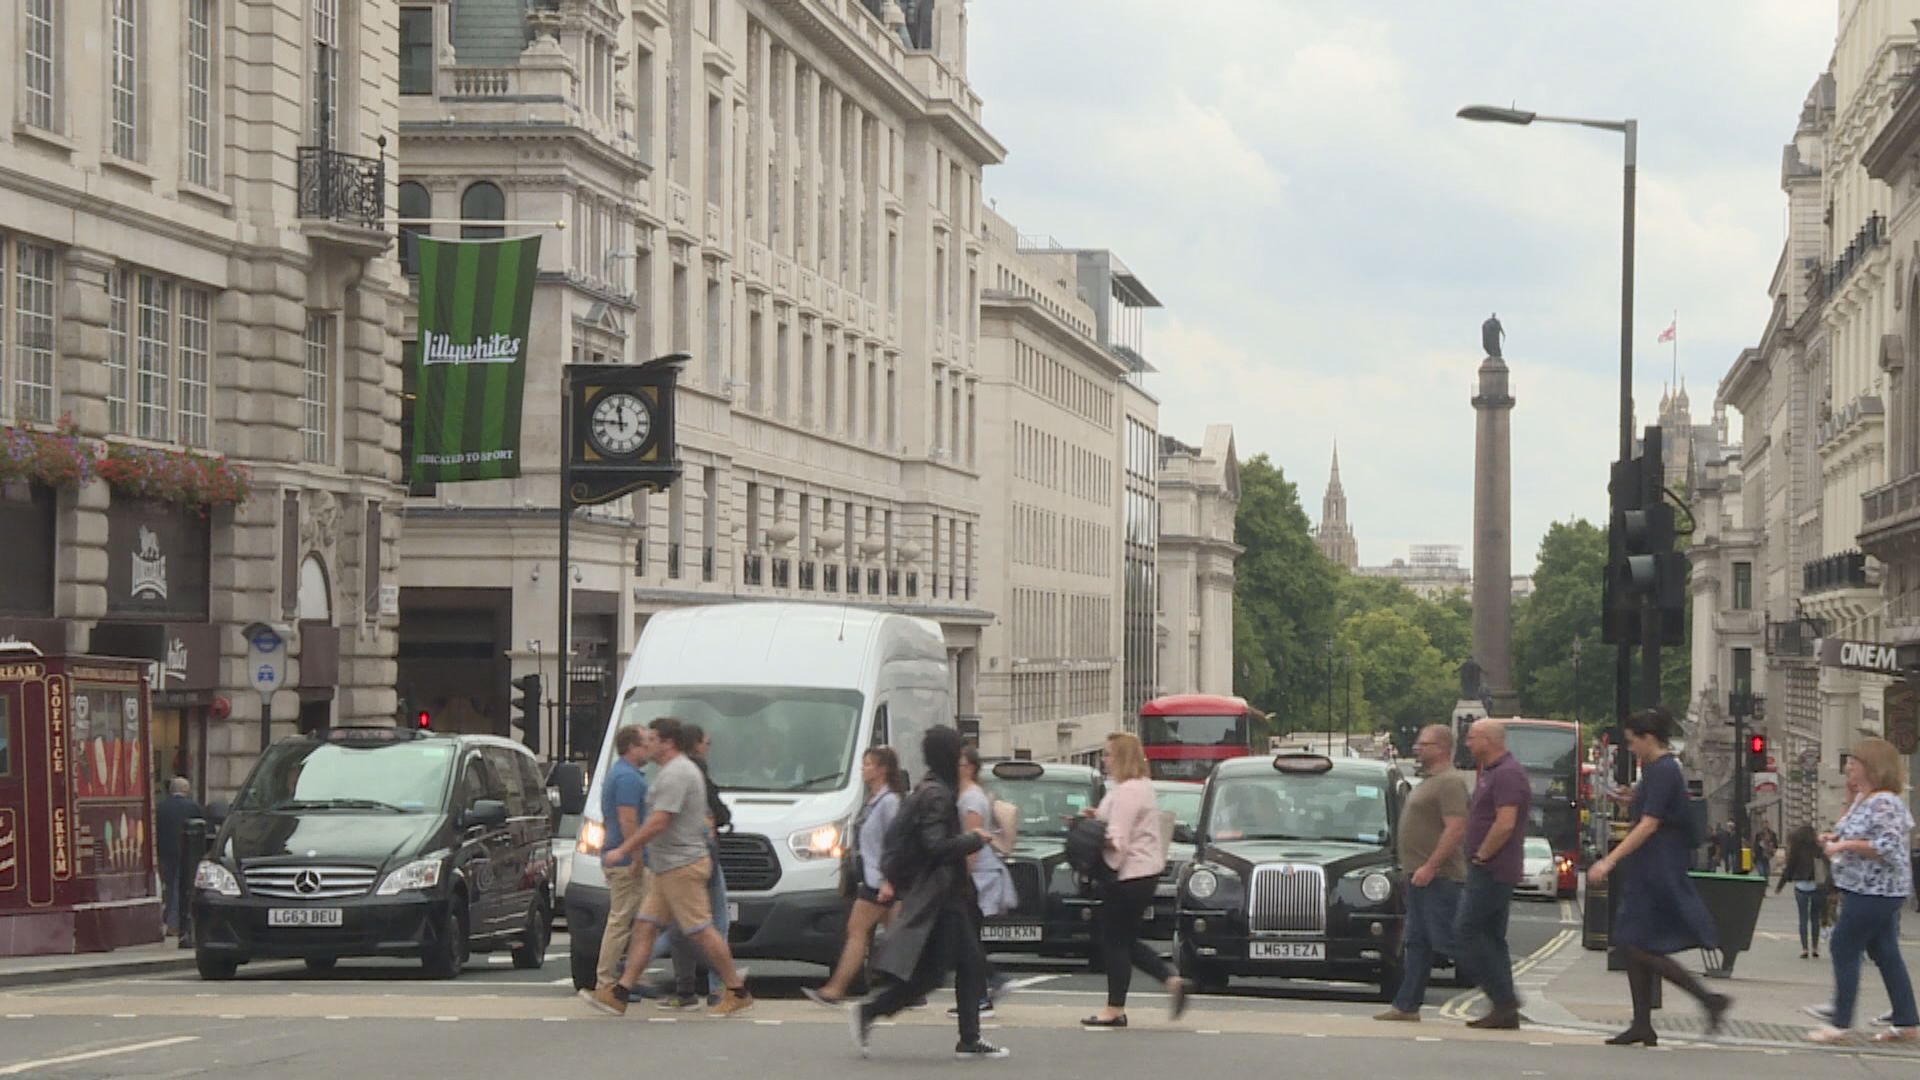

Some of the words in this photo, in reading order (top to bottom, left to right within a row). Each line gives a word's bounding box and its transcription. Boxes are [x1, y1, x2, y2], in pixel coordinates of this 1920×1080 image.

[423, 329, 520, 366] Lillywhites
[466, 452, 480, 463] TO
[1840, 642, 1902, 671] CINEM
[51, 684, 62, 732] SOFT
[53, 737, 64, 772] ICE
[54, 808, 68, 873] CREAM
[1255, 944, 1290, 955] LM63
[1294, 944, 1319, 957] EZA
